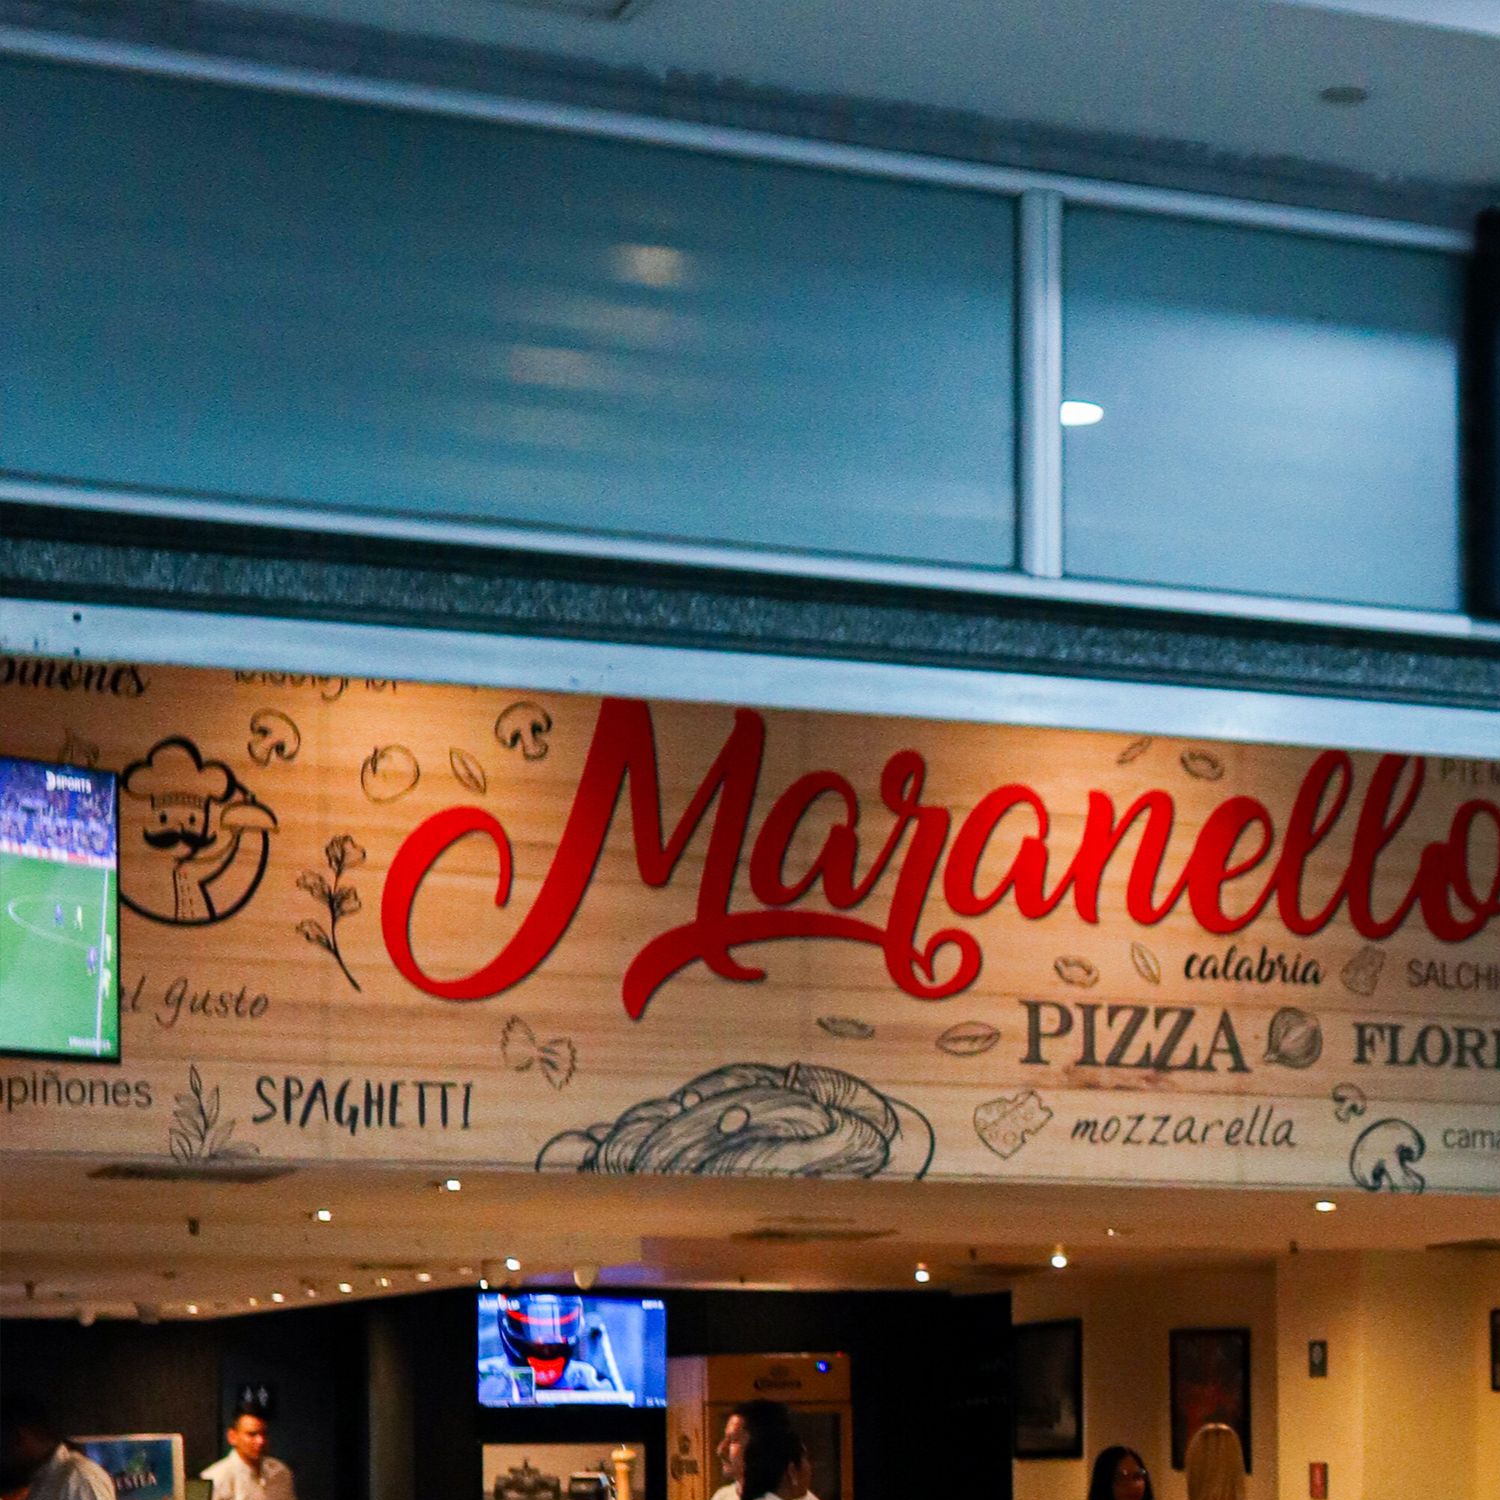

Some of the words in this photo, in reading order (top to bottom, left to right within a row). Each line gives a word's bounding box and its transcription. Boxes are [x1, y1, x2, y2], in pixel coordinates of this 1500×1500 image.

[1185, 946, 1324, 986] calabria
[154, 977, 270, 1029] gusto
[1019, 1000, 1252, 1073] PIZZA
[0, 1069, 153, 1112] piñones
[252, 1075, 474, 1136] SPAGHETTI
[1072, 1105, 1297, 1149] mozzarella
